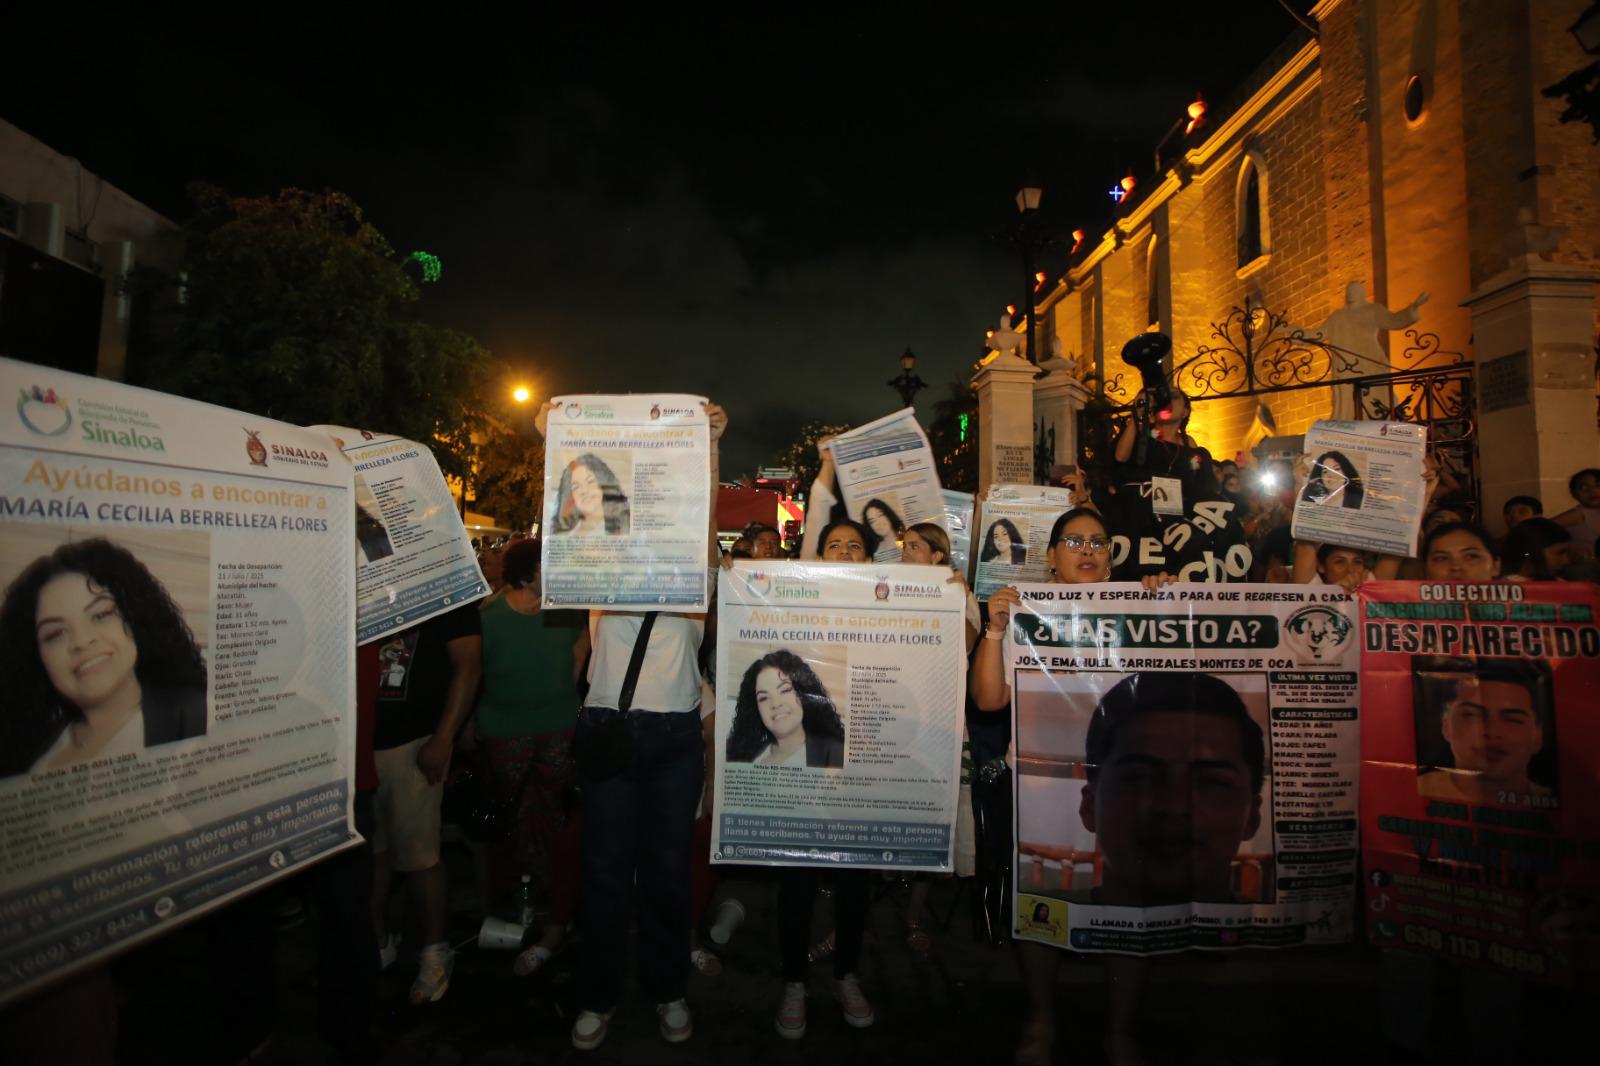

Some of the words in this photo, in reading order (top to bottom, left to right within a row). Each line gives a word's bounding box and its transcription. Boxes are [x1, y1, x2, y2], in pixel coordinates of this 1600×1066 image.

[81, 421, 165, 451] Sinaloa
[588, 440, 617, 448] CECILIA
[271, 444, 328, 462] SINALOA
[392, 450, 419, 462] FLORES
[24, 458, 182, 497] Ayúdanos
[191, 482, 205, 499] a
[212, 483, 314, 509] encontrar
[316, 498, 328, 512] a
[0, 496, 89, 519] MARÍA
[97, 501, 174, 524] CECILIA
[180, 509, 277, 529] BERRELLEZA
[281, 514, 328, 532] FLORES
[775, 584, 820, 600] Sinaloa
[893, 584, 942, 593] SINALOA
[1059, 591, 1082, 601] LUZ
[1088, 591, 1095, 601] Y
[1100, 591, 1176, 602] ESPERANZA
[1180, 591, 1214, 601] PARA
[1218, 591, 1240, 601] QUE
[1245, 592, 1304, 602] REGRESEN
[1309, 593, 1317, 602] A
[1321, 593, 1353, 602] CASA
[1420, 584, 1524, 601] COLECTIVO
[749, 610, 828, 627] Ayúdanos
[834, 615, 843, 626] a
[848, 614, 925, 629] encontrar
[931, 618, 941, 629] a
[740, 628, 778, 641] MARÍA
[781, 630, 824, 642] CECILIA
[827, 632, 896, 644] BERRELLEZA
[899, 633, 942, 645] FLORES
[1034, 618, 1119, 643] ¿HAS
[1126, 618, 1219, 644] VISTO
[1226, 618, 1262, 644] A?
[1364, 622, 1600, 659] DESAPARECIDO
[1120, 657, 1196, 669] CARRIZALES
[1200, 658, 1245, 669] MONTES
[1248, 659, 1263, 669] DE
[1268, 659, 1294, 669] OCA
[725, 817, 734, 825] Si
[738, 818, 765, 827] tienes
[769, 819, 824, 830] información
[827, 822, 868, 832] referente
[882, 825, 901, 833] esta
[905, 826, 945, 836] persona,
[724, 827, 749, 836] llama
[815, 831, 826, 840] Tu
[827, 832, 855, 842] ayuda
[871, 835, 890, 844] muy
[0, 885, 63, 917] ienes
[73, 843, 179, 889] información
[185, 820, 248, 849] referente
[254, 815, 262, 826] a
[266, 802, 292, 820] esta
[296, 787, 343, 810] persona,
[186, 841, 229, 867] ayuda
[233, 837, 248, 851] es
[251, 826, 278, 843] muy
[1090, 918, 1134, 929] LLAMADA
[1145, 918, 1181, 929] MENSAJE
